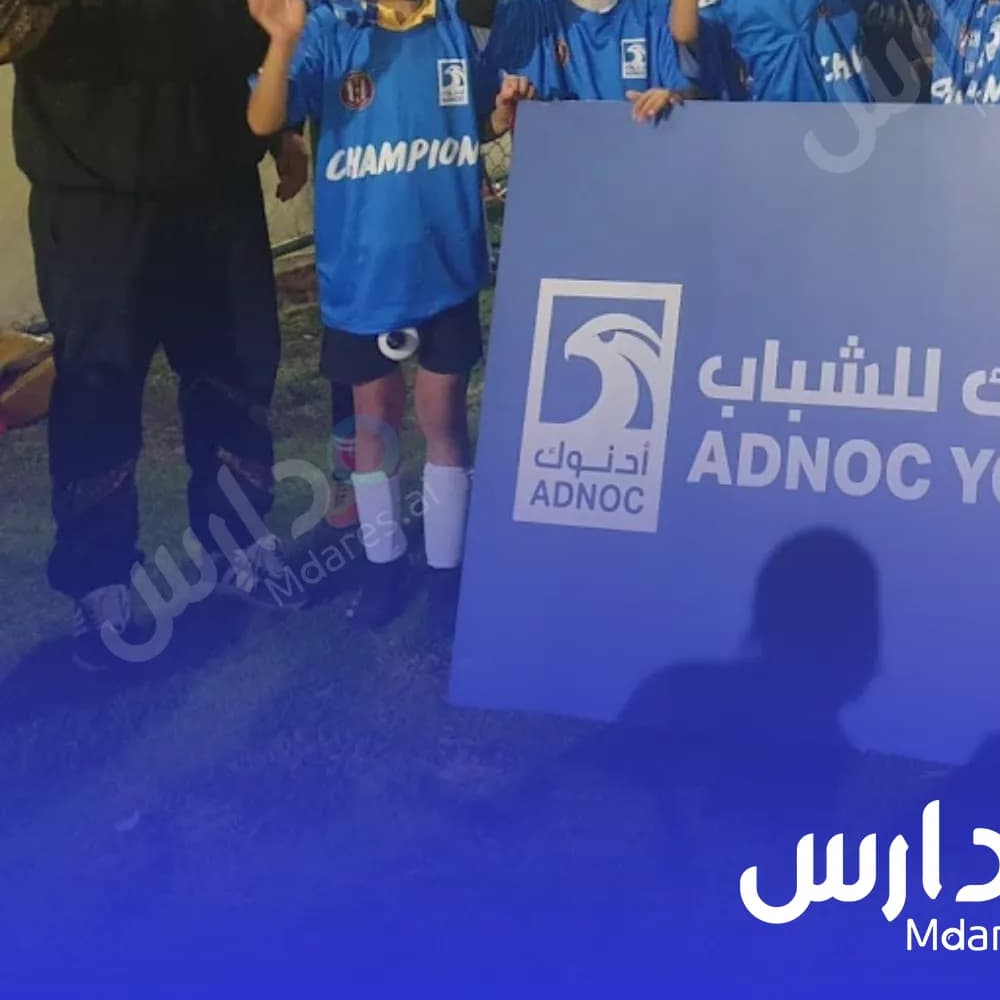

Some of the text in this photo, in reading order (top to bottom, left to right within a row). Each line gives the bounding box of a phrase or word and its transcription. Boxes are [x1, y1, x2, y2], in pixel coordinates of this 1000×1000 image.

[699, 335, 942, 422] للشباب
[534, 440, 651, 478] أدنوك
[686, 429, 932, 500] ADNOC
[529, 478, 645, 515] ADNOC
